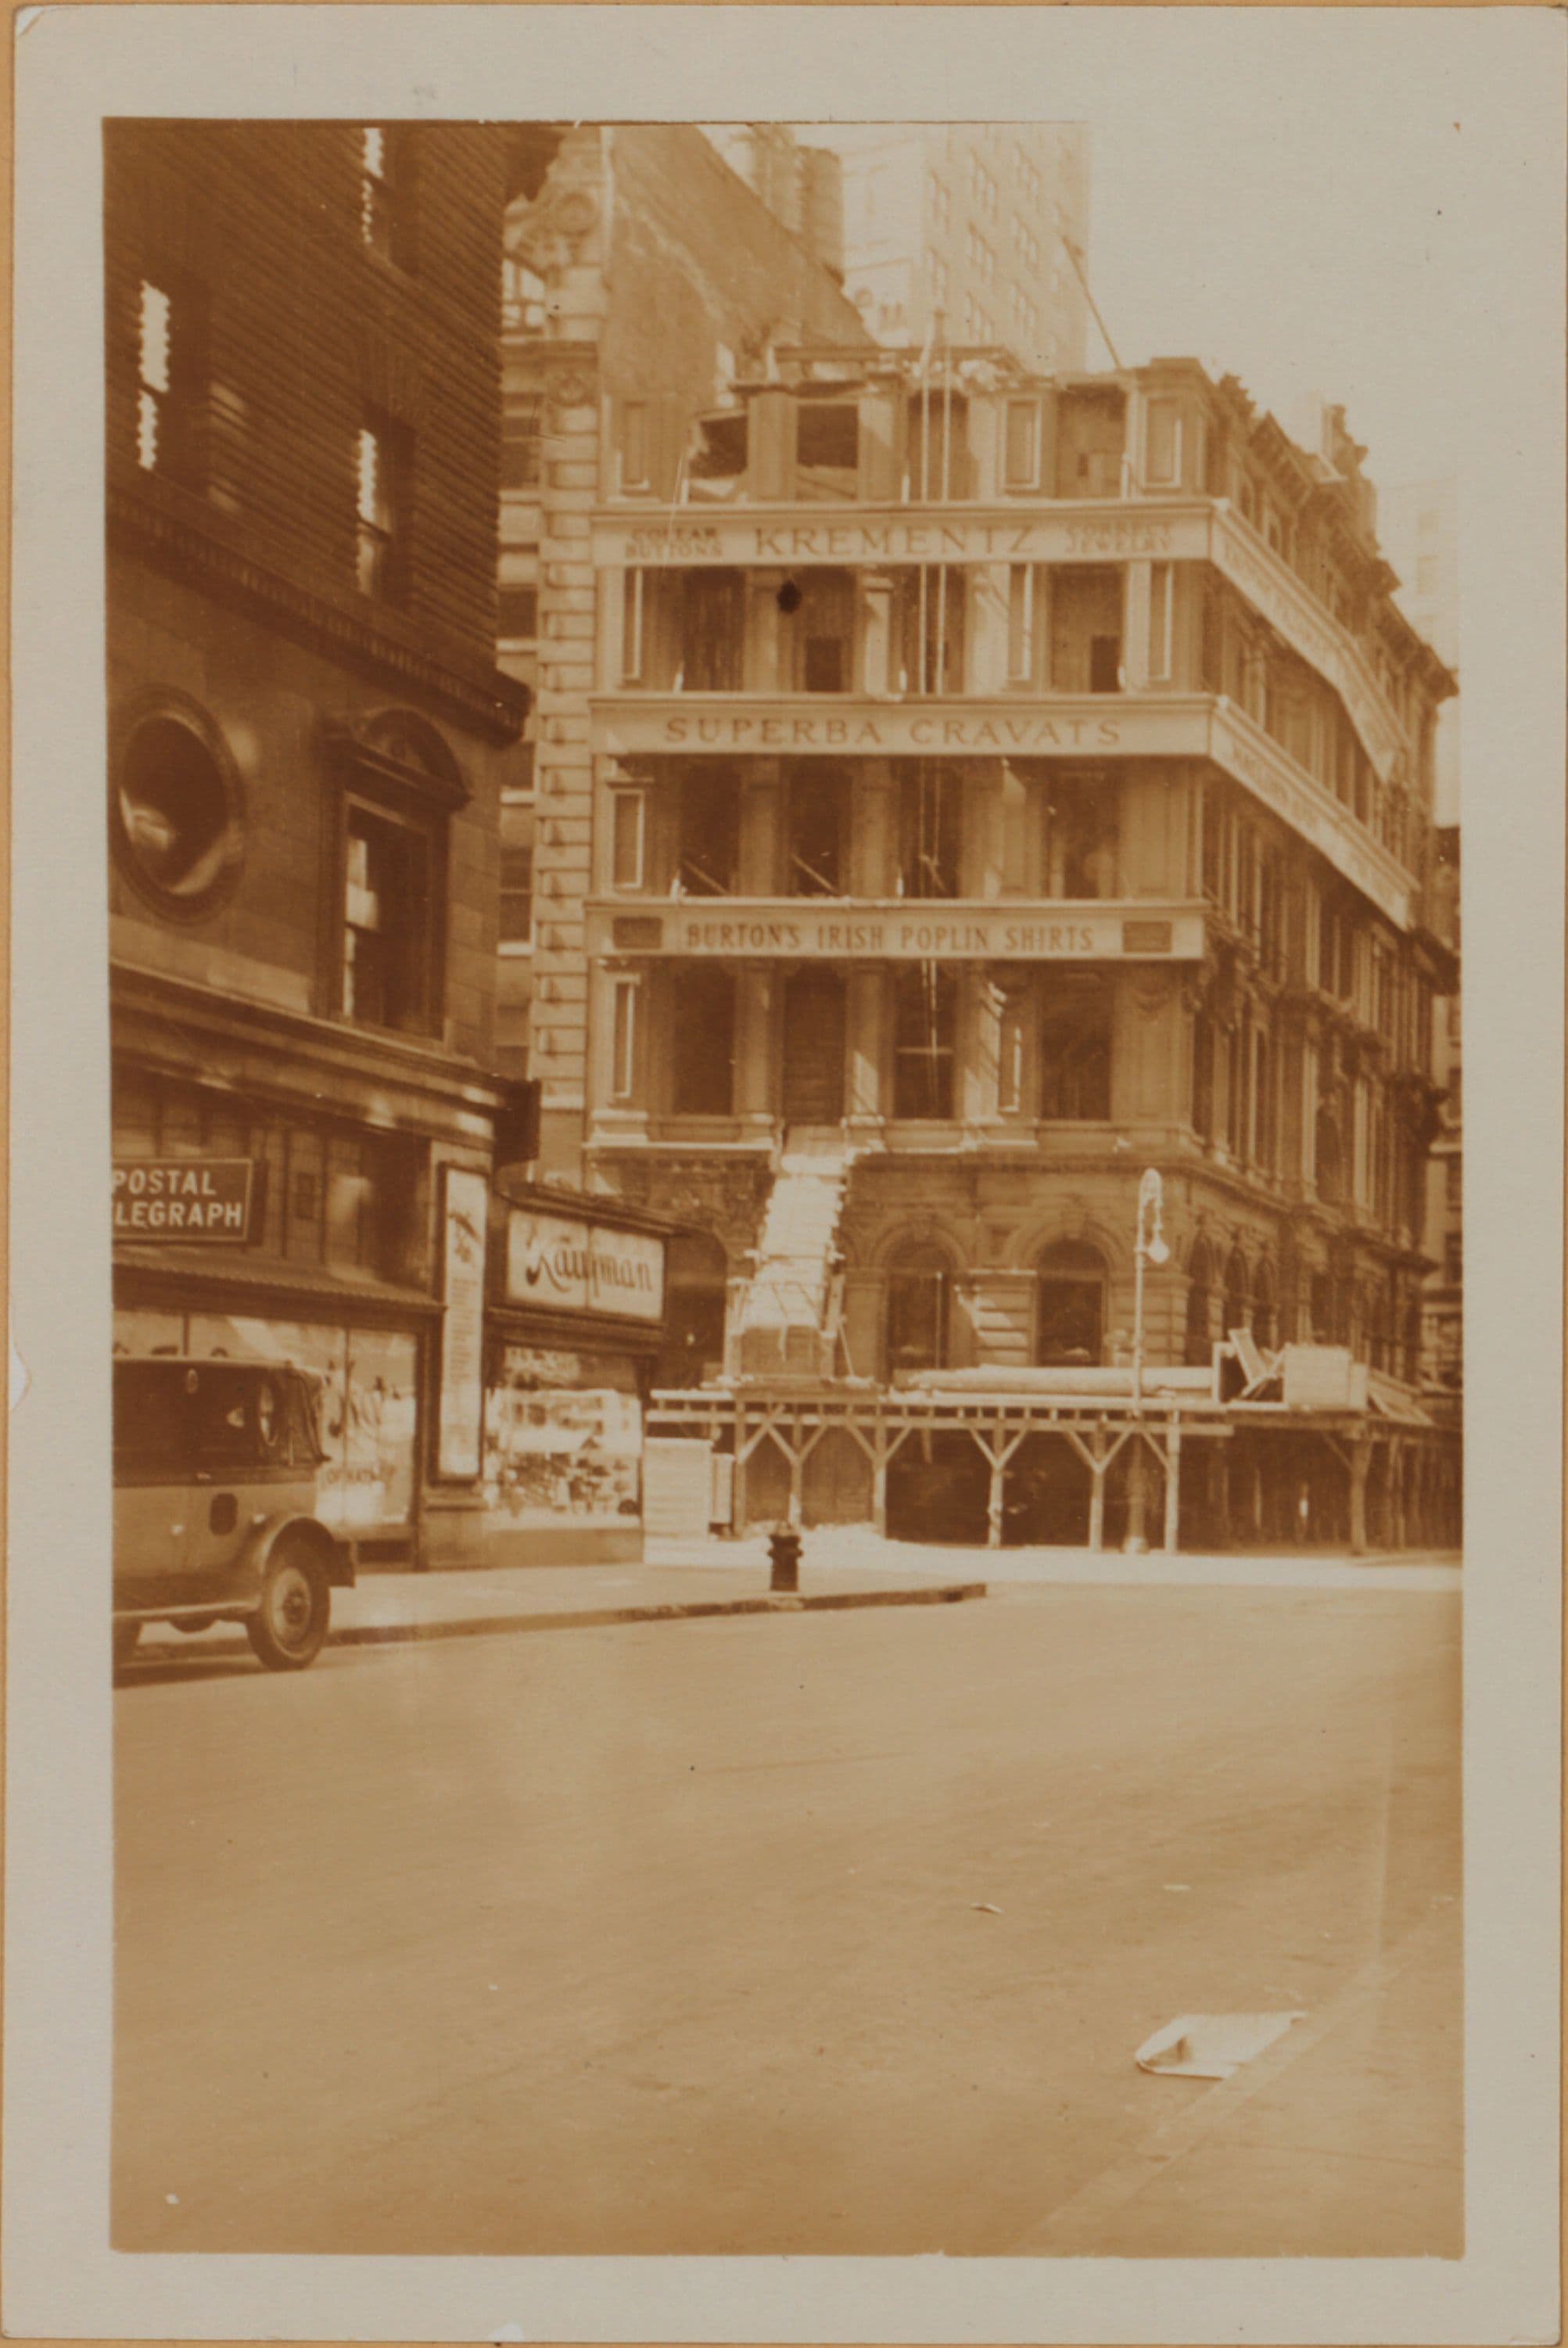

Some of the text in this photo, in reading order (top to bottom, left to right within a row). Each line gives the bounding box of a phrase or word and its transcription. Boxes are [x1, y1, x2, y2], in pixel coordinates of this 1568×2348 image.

[754, 525, 1036, 556] KREMENTZ
[665, 717, 1121, 745] SUPERBA CRAVATS
[817, 924, 884, 950] IRISH
[900, 924, 989, 951] POPLIN
[1005, 925, 1094, 951] SHIRTS
[112, 1169, 217, 1196] POSTAL
